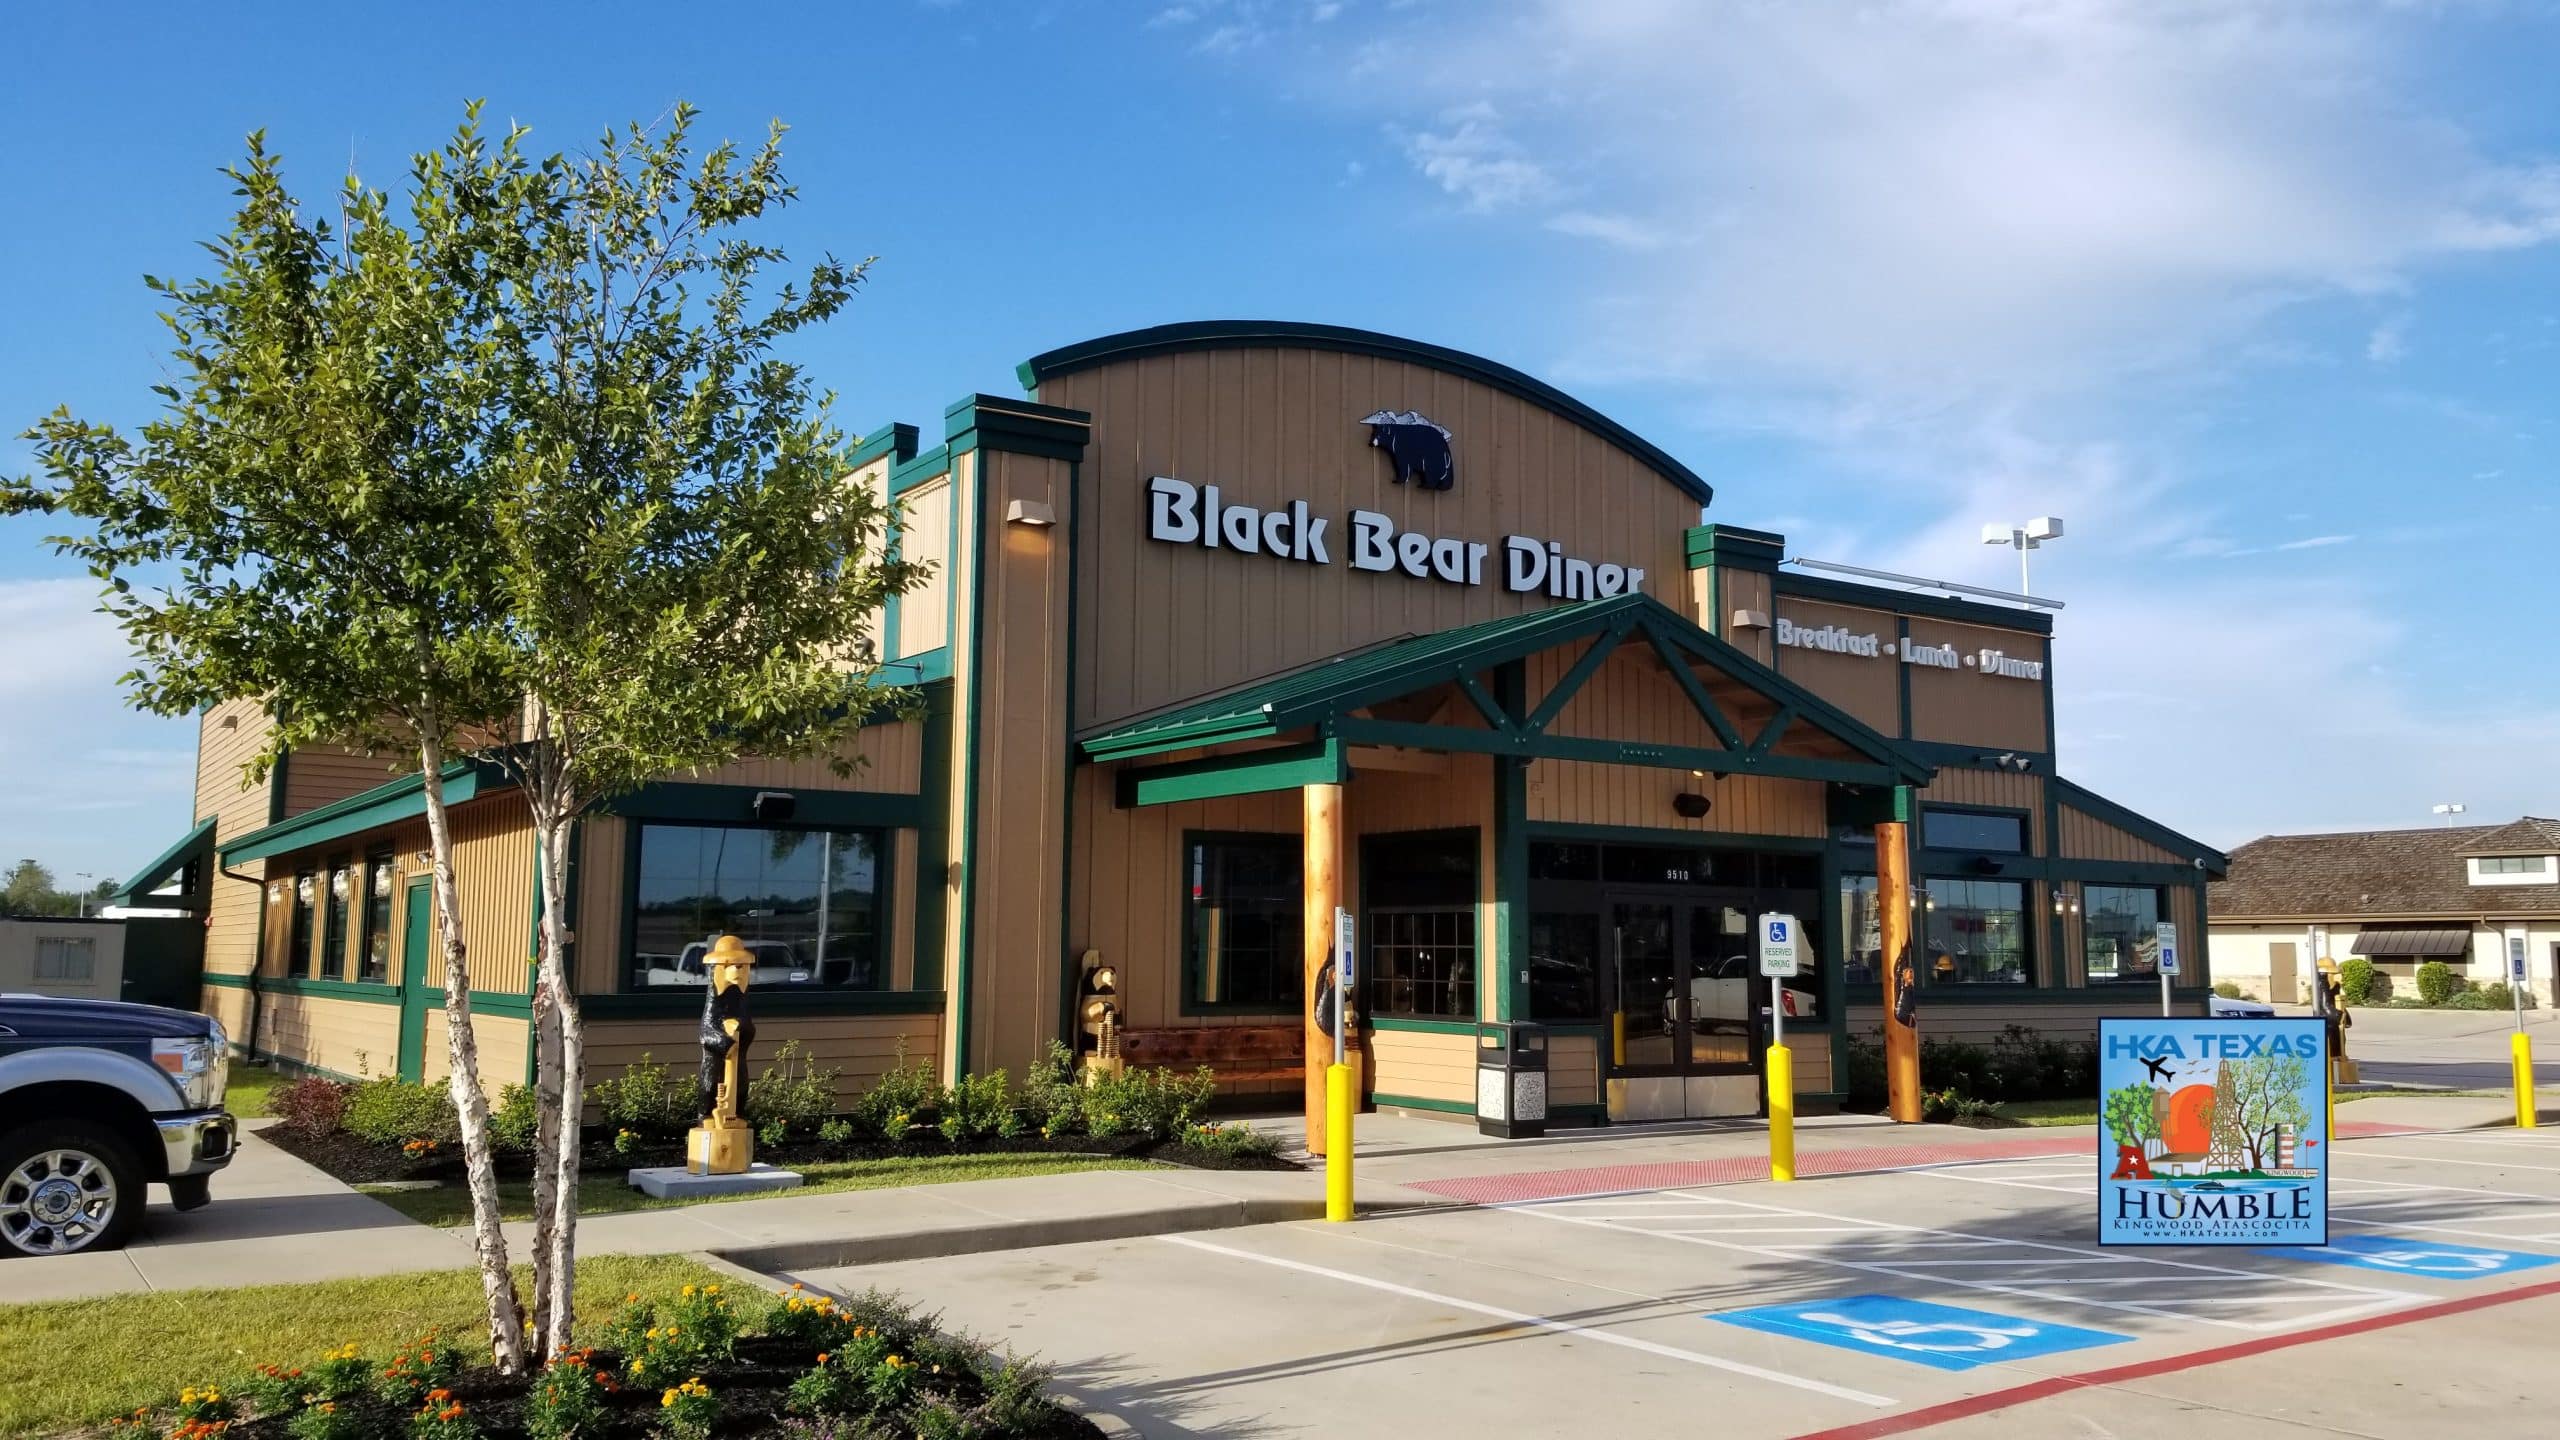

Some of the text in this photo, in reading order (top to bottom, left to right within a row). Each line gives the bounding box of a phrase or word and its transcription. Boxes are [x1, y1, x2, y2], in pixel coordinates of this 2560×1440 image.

[1147, 476, 1644, 601] Black Bear Diner
[1777, 618, 2044, 681] Breakfast Lunch Dinner
[1666, 869, 1689, 880] 9510
[1764, 947, 1793, 957] RESERVED
[1767, 959, 1790, 968] PARKING
